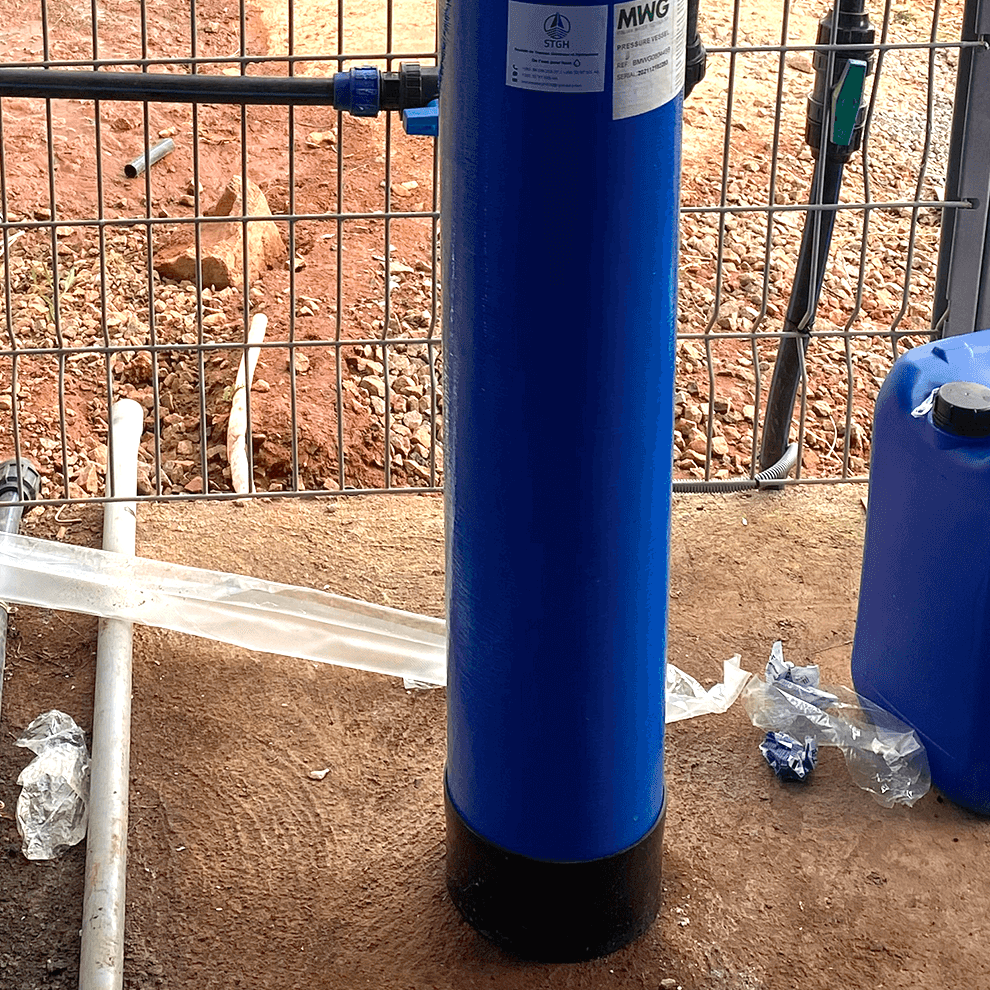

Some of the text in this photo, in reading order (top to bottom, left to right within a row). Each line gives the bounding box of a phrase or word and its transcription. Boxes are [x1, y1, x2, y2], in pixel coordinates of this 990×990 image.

[544, 39, 570, 49] STGH
[616, 30, 670, 51] PRESSURE VESSEL
